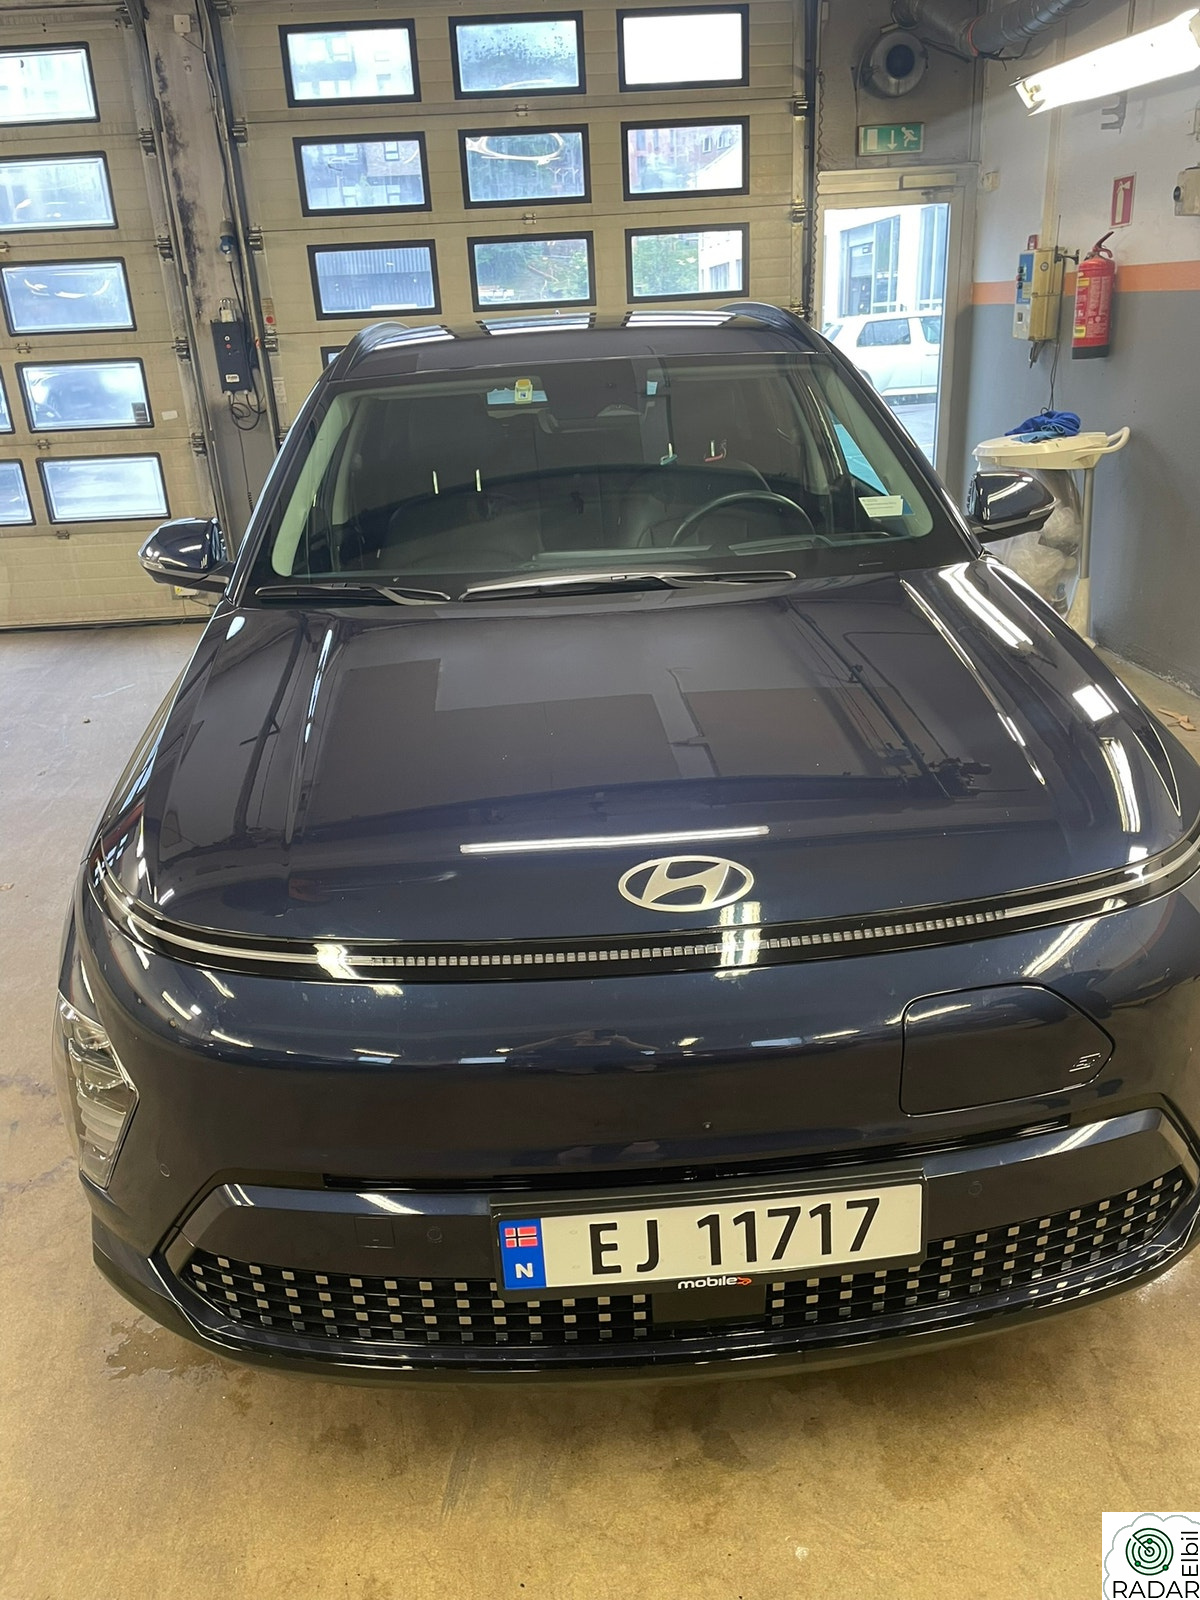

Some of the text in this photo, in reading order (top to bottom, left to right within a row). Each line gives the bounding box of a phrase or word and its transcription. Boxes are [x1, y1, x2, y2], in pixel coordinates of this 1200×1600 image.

[589, 1197, 881, 1276] EJ 11717
[515, 1263, 534, 1279] N
